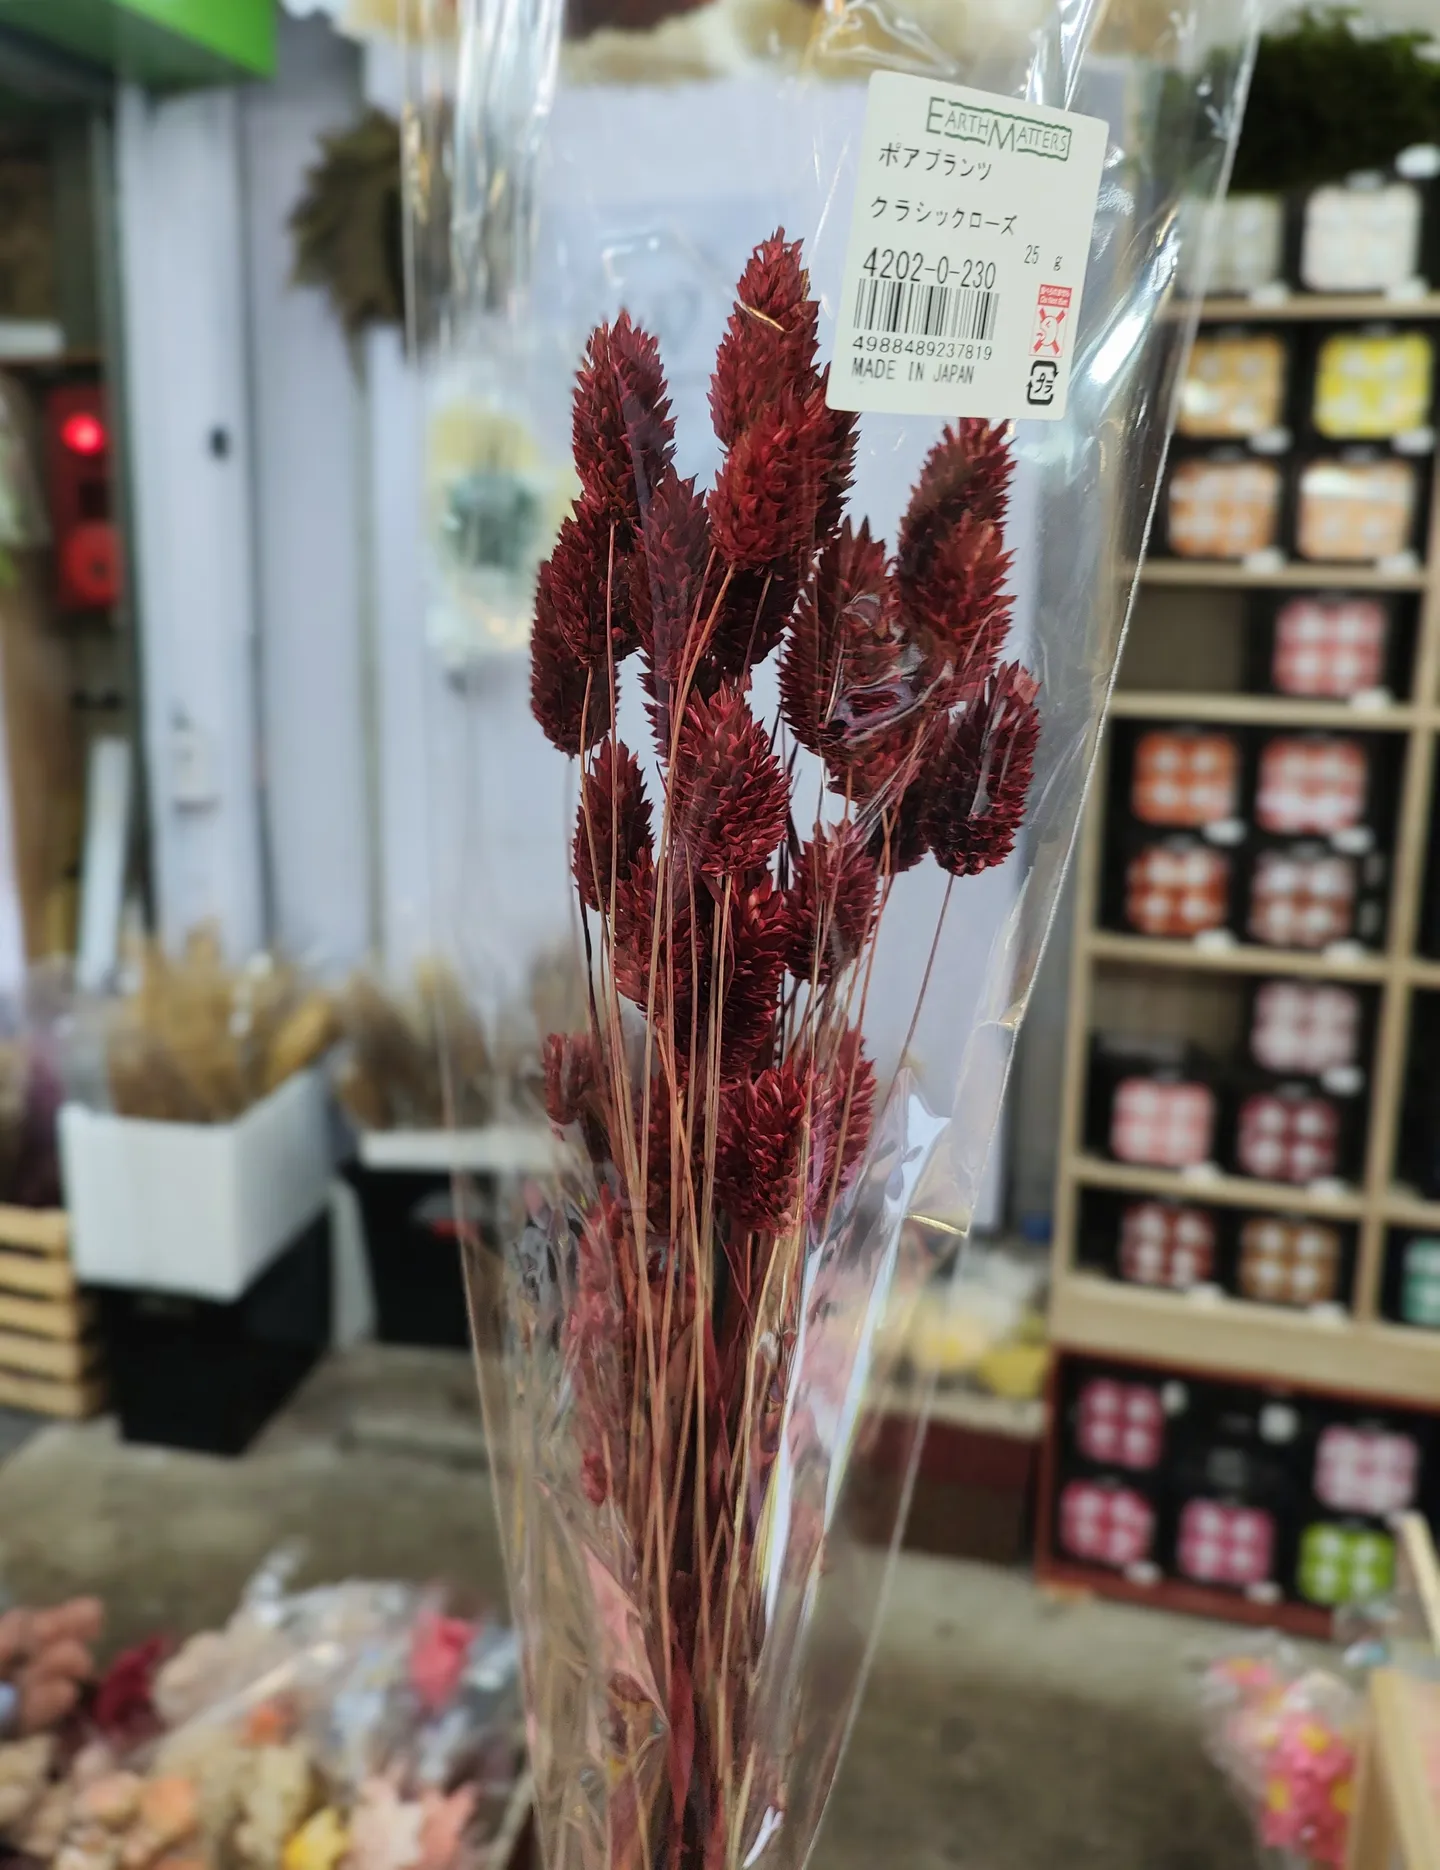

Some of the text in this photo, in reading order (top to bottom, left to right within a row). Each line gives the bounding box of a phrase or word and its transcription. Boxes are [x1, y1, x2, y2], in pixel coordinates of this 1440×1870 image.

[870, 196, 1018, 235] クラシックローズ
[863, 247, 996, 290] 4202-0-230
[1023, 245, 1040, 265] 25
[852, 336, 992, 361] 4988489237819
[852, 357, 975, 385] MADE IN JAPAN
